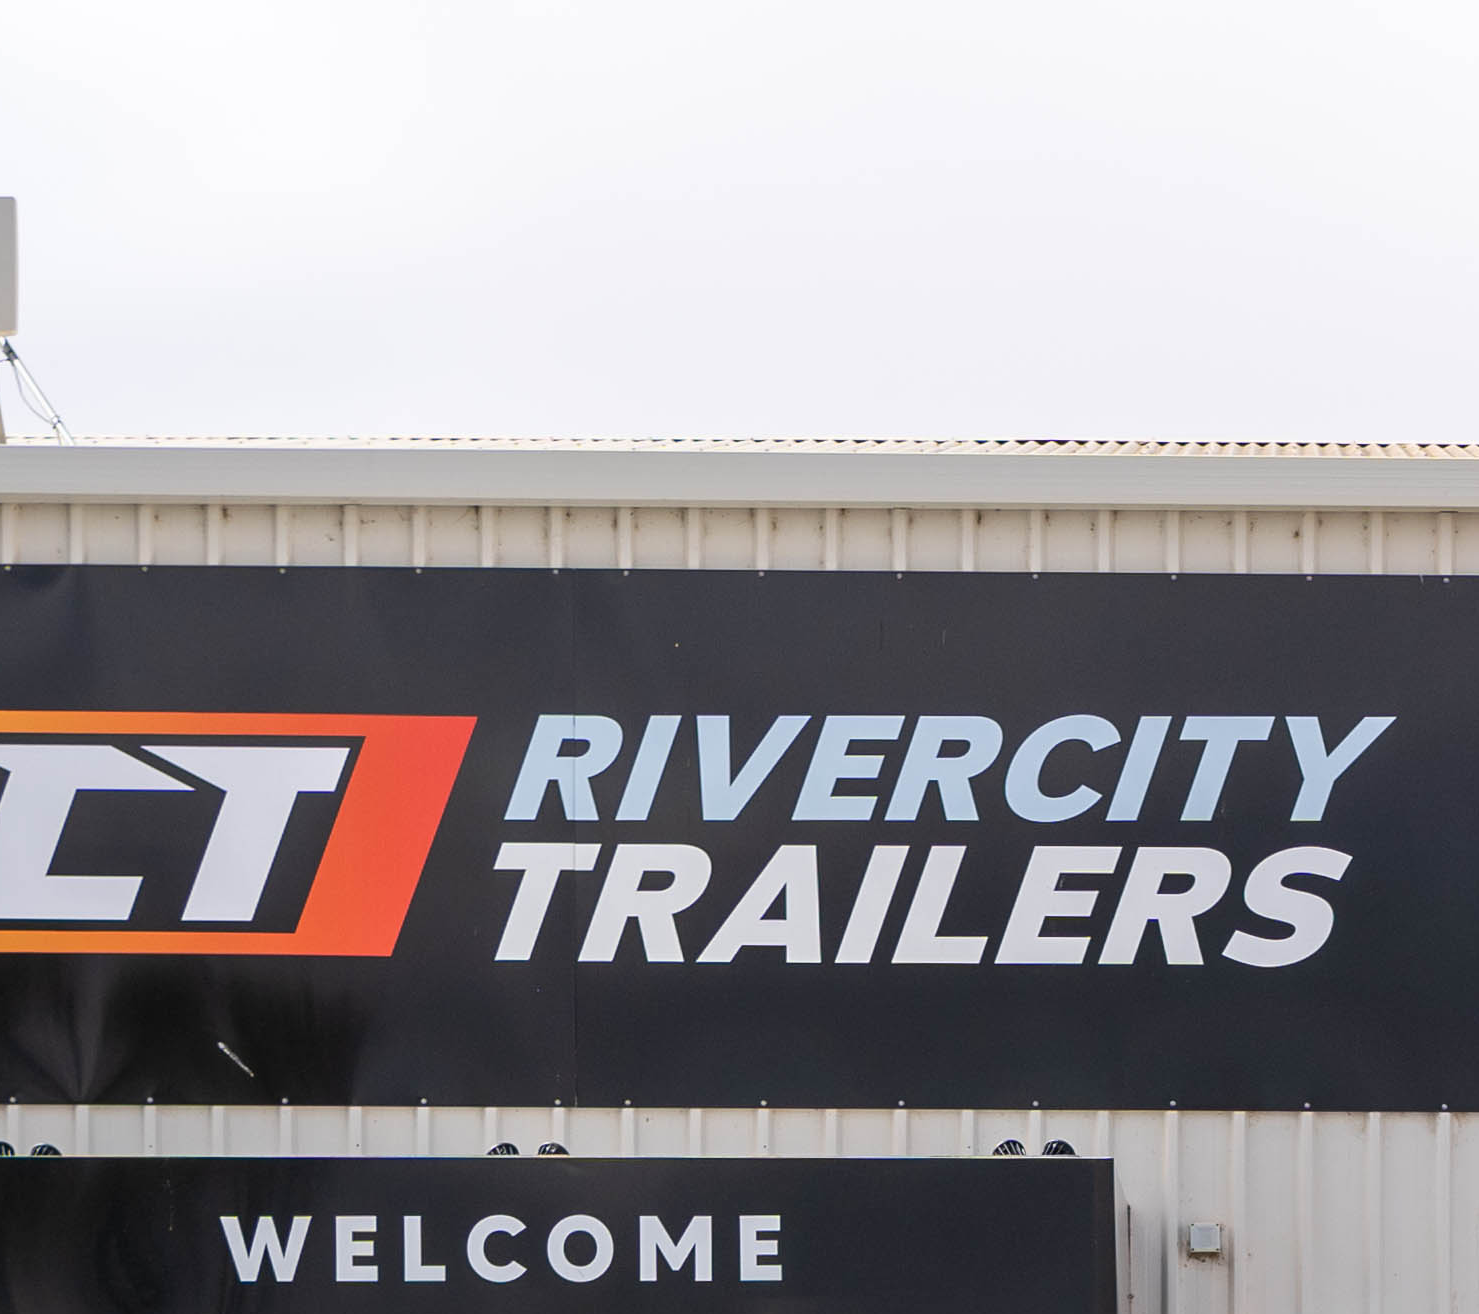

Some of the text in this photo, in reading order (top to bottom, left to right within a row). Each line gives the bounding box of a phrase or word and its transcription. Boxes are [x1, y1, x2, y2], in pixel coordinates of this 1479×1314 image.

[509, 714, 1397, 824] RIVERCITY
[491, 843, 1354, 969] TRAILERS
[218, 1212, 787, 1286] WELCOME
